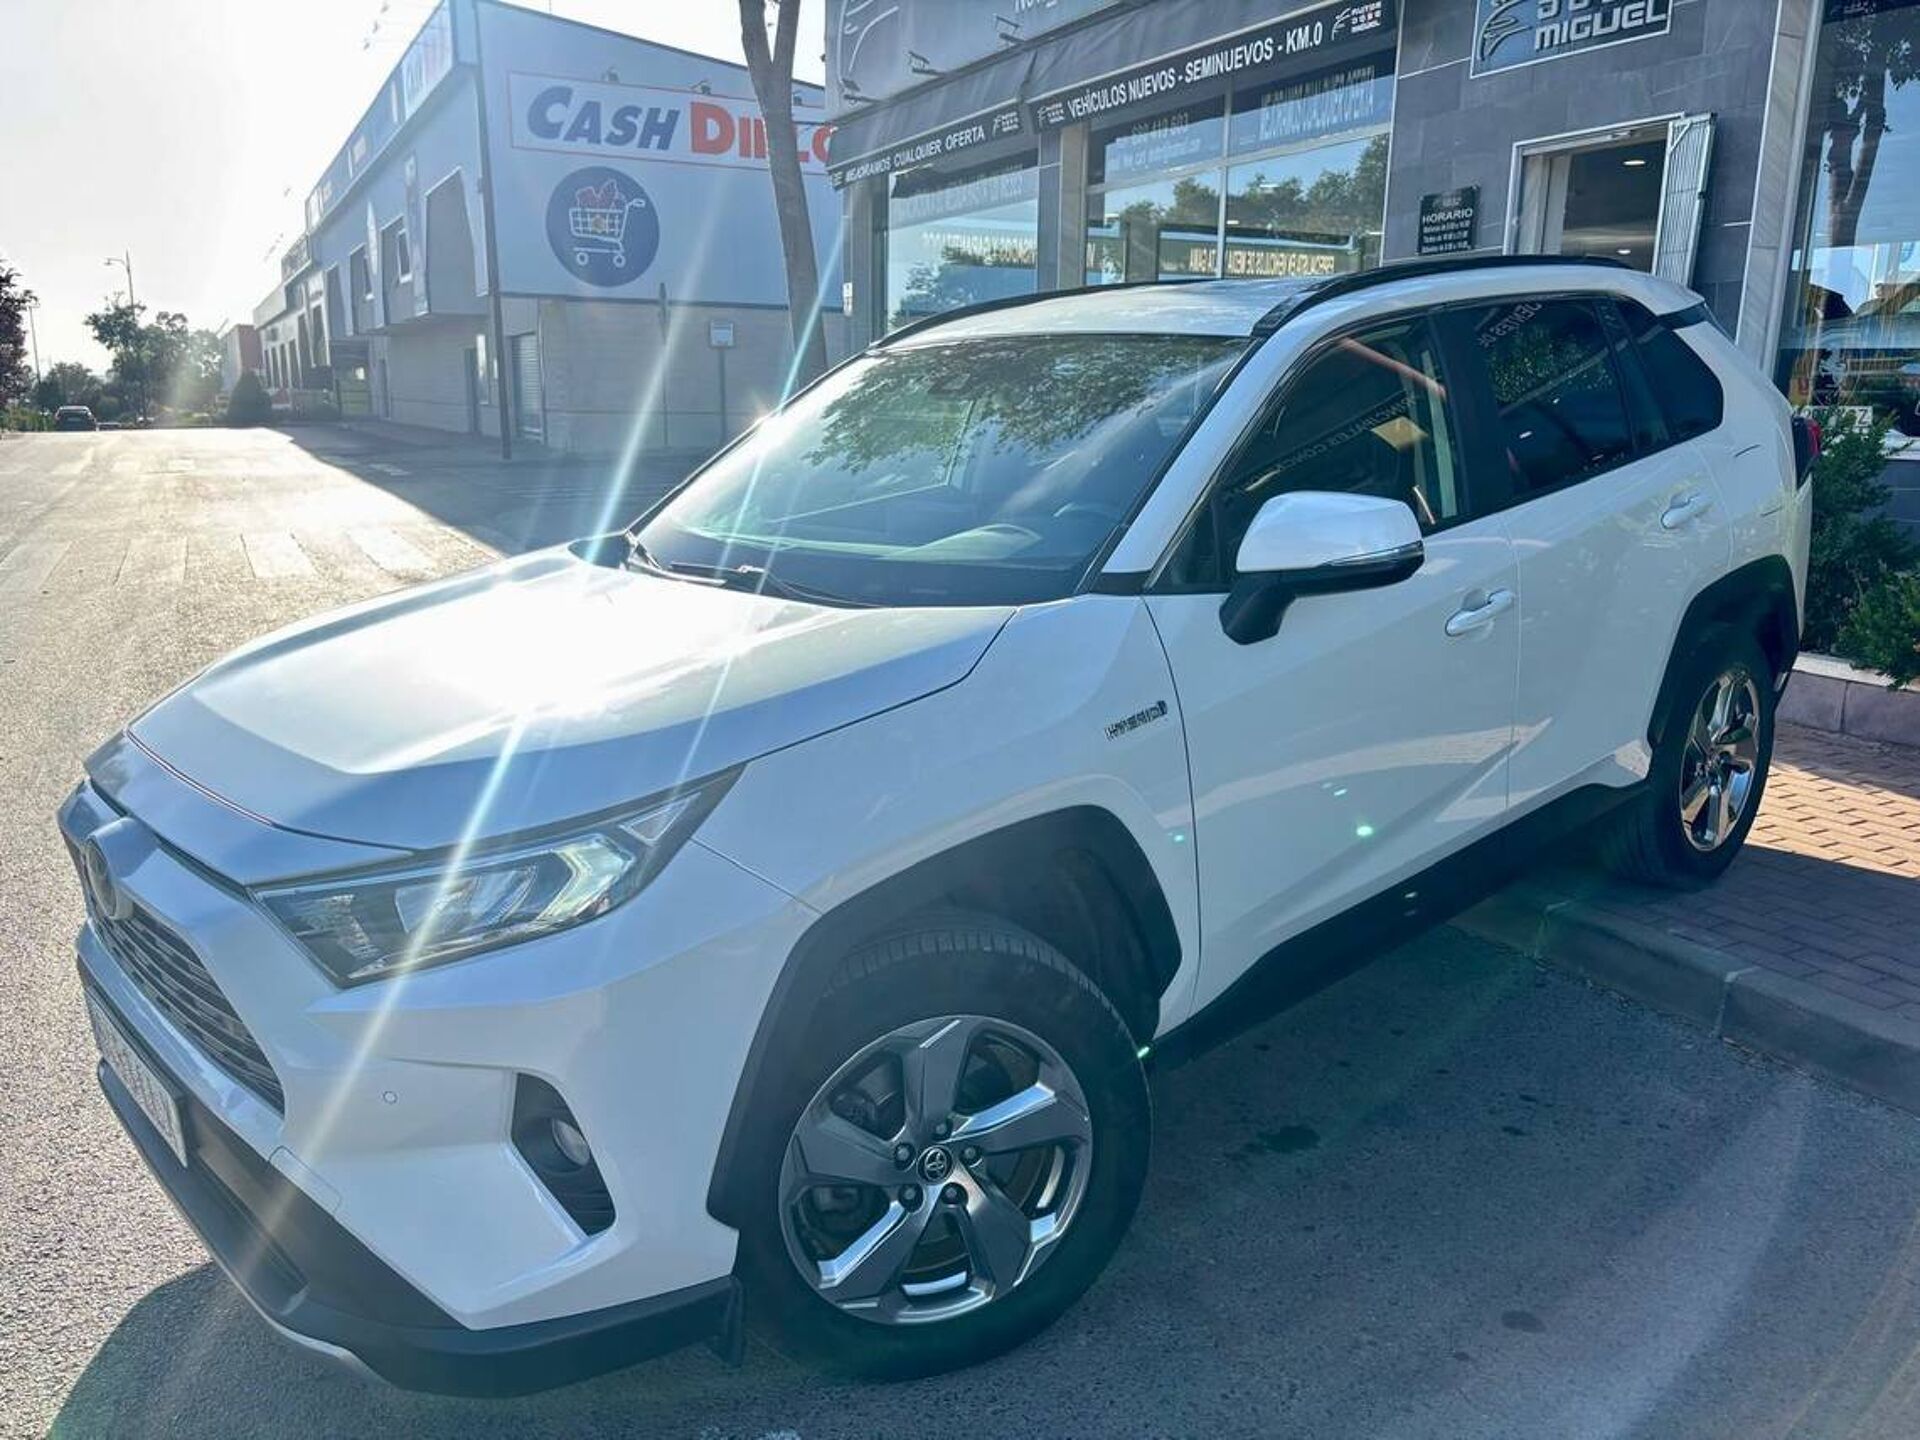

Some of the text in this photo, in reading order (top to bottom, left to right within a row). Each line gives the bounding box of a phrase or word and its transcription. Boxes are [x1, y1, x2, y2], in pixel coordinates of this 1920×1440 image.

[1535, 0, 1667, 50] MIGUEL
[1128, 67, 1176, 101] NUEVOS
[1185, 37, 1274, 84] SEMINUEVOS
[1286, 21, 1323, 54] KM.0
[527, 86, 680, 150] CASH
[893, 139, 943, 168] CUALQUIER
[945, 125, 986, 150] OFERTA
[1422, 208, 1473, 224] HORARIO
